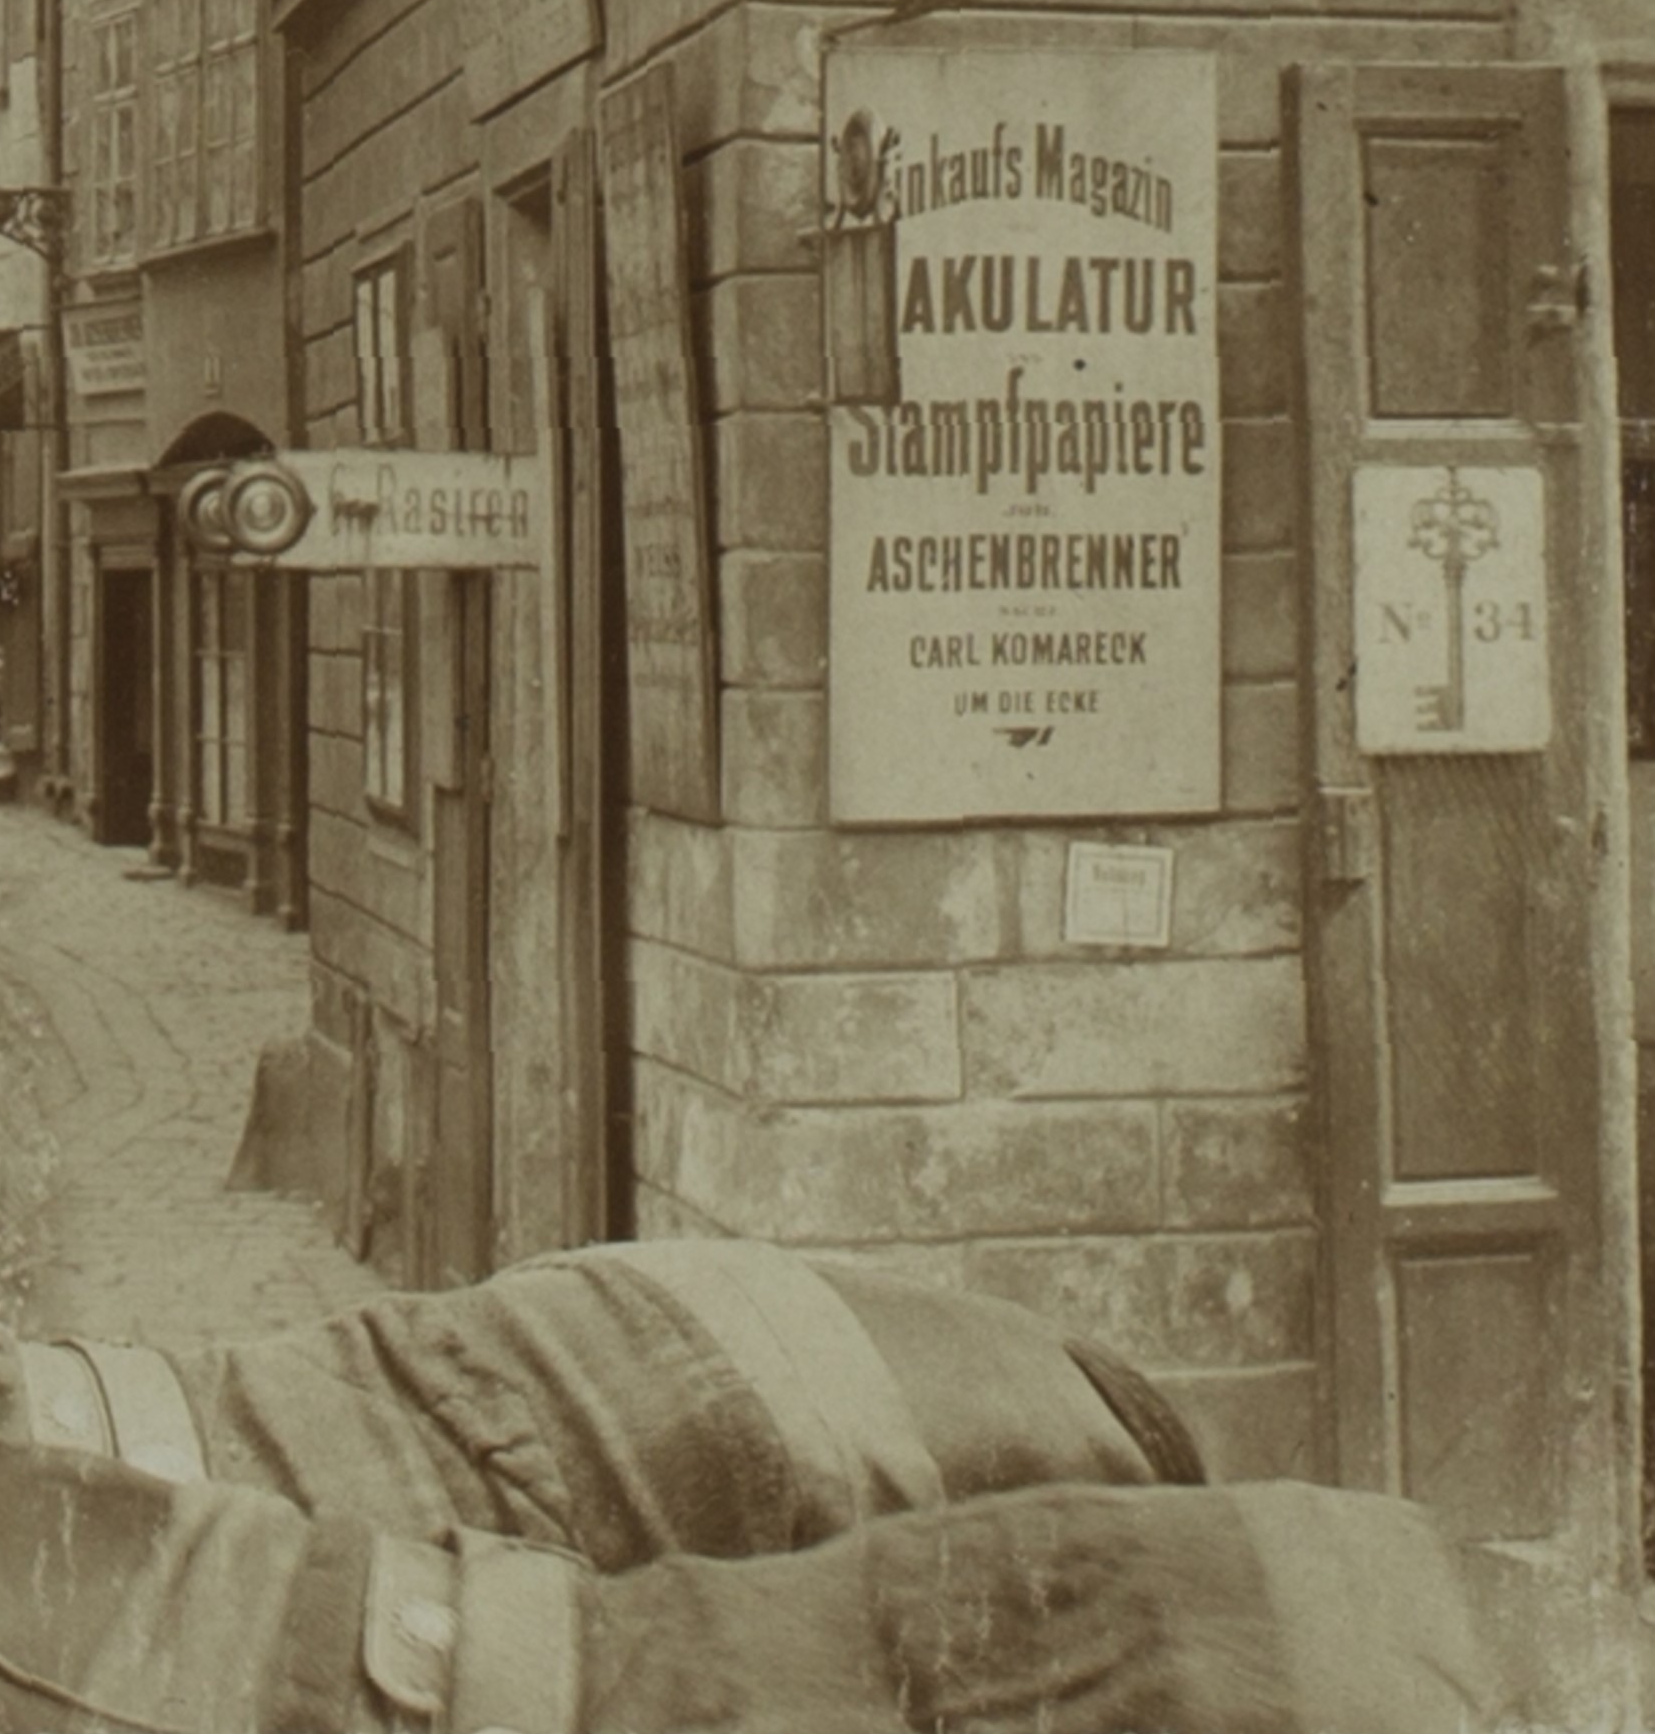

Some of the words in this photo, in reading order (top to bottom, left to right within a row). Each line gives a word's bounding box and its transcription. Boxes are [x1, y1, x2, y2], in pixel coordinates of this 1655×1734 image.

[891, 123, 1023, 218] inkaufs
[1035, 123, 1174, 233] Magazin
[900, 254, 1197, 335] AKULATUR
[866, 532, 1182, 593] ASCHENBRENNER
[1473, 599, 1536, 643] 34
[909, 633, 981, 668] CARL
[991, 630, 1148, 666] KOMARECK
[953, 691, 989, 716] UM
[998, 689, 1034, 714] DIE
[1046, 688, 1100, 714] ECKE
